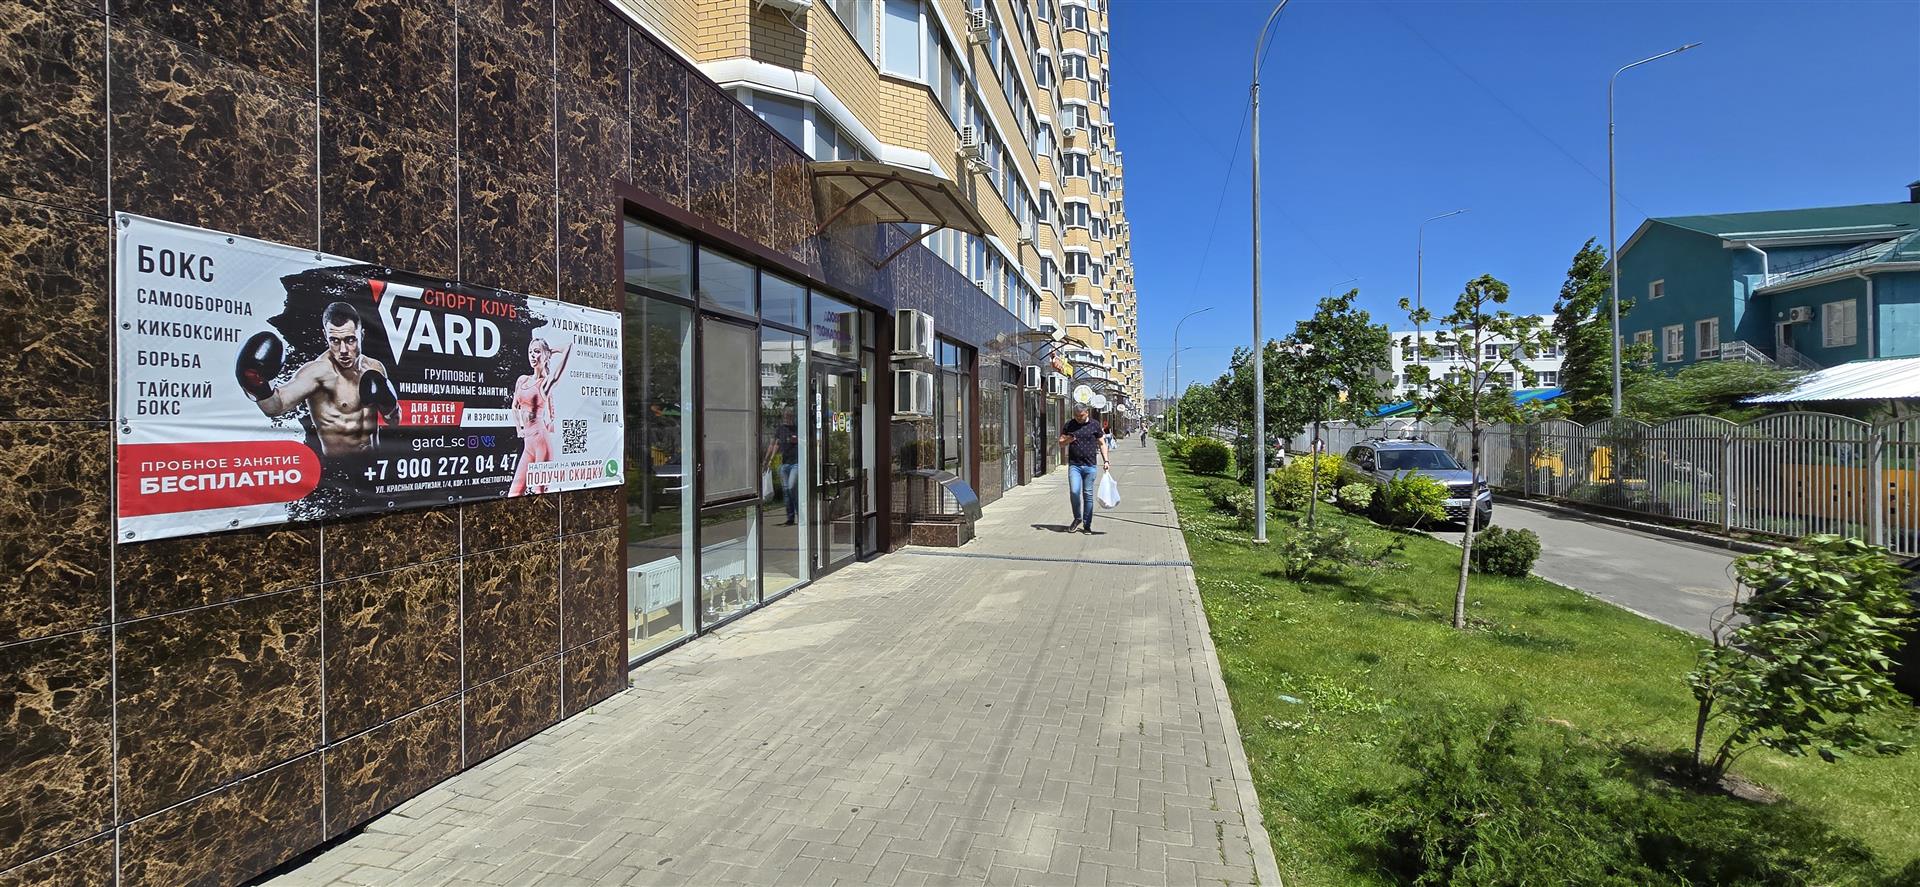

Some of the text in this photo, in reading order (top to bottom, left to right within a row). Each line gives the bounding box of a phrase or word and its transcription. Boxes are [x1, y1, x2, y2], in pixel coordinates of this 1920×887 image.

[138, 244, 214, 283] БОКС
[137, 288, 253, 317] САМООБОРОНА
[424, 289, 517, 319] СПОРТ КЛУБ
[137, 319, 242, 343] КИКБОКСИНГ
[378, 282, 501, 366] GARD
[551, 317, 618, 337] ХУДОЖЕСТВЕННАЯ
[573, 334, 618, 349] ГИМНАСТИКА
[137, 350, 201, 369] БОРЬБА
[424, 368, 484, 383] ГРУППОВЫЕ И
[137, 379, 212, 398] ТАЙСКИЙ
[399, 382, 508, 397] ИНДИВИДУАЛЬНЫЕ ЗАНЯТИЯ
[581, 386, 619, 397] СТРЕТЧИНГ
[137, 400, 181, 415] БОКС
[411, 402, 456, 413] ДЛЯ ДЕТЕЙ
[411, 414, 421, 424] ОТ
[440, 414, 456, 424] ЛЕТ
[467, 413, 509, 421] И ВЗРОСЛЫХ
[602, 412, 619, 424] ЙОГА
[411, 435, 465, 451] gard_sc
[141, 455, 300, 472] ПРОБНОЕ ЗАНЯТИЕ
[364, 453, 518, 481] +7 900 272 04 47
[528, 463, 559, 471] НАПИШИ
[570, 459, 603, 467] WHATSAPP
[140, 469, 302, 495] БЕСПЛАТНО
[527, 467, 604, 486] ПОЛУЧИ СКИДКУ
[375, 485, 386, 494] УЛ.
[386, 483, 414, 492] КРАСНЫХ
